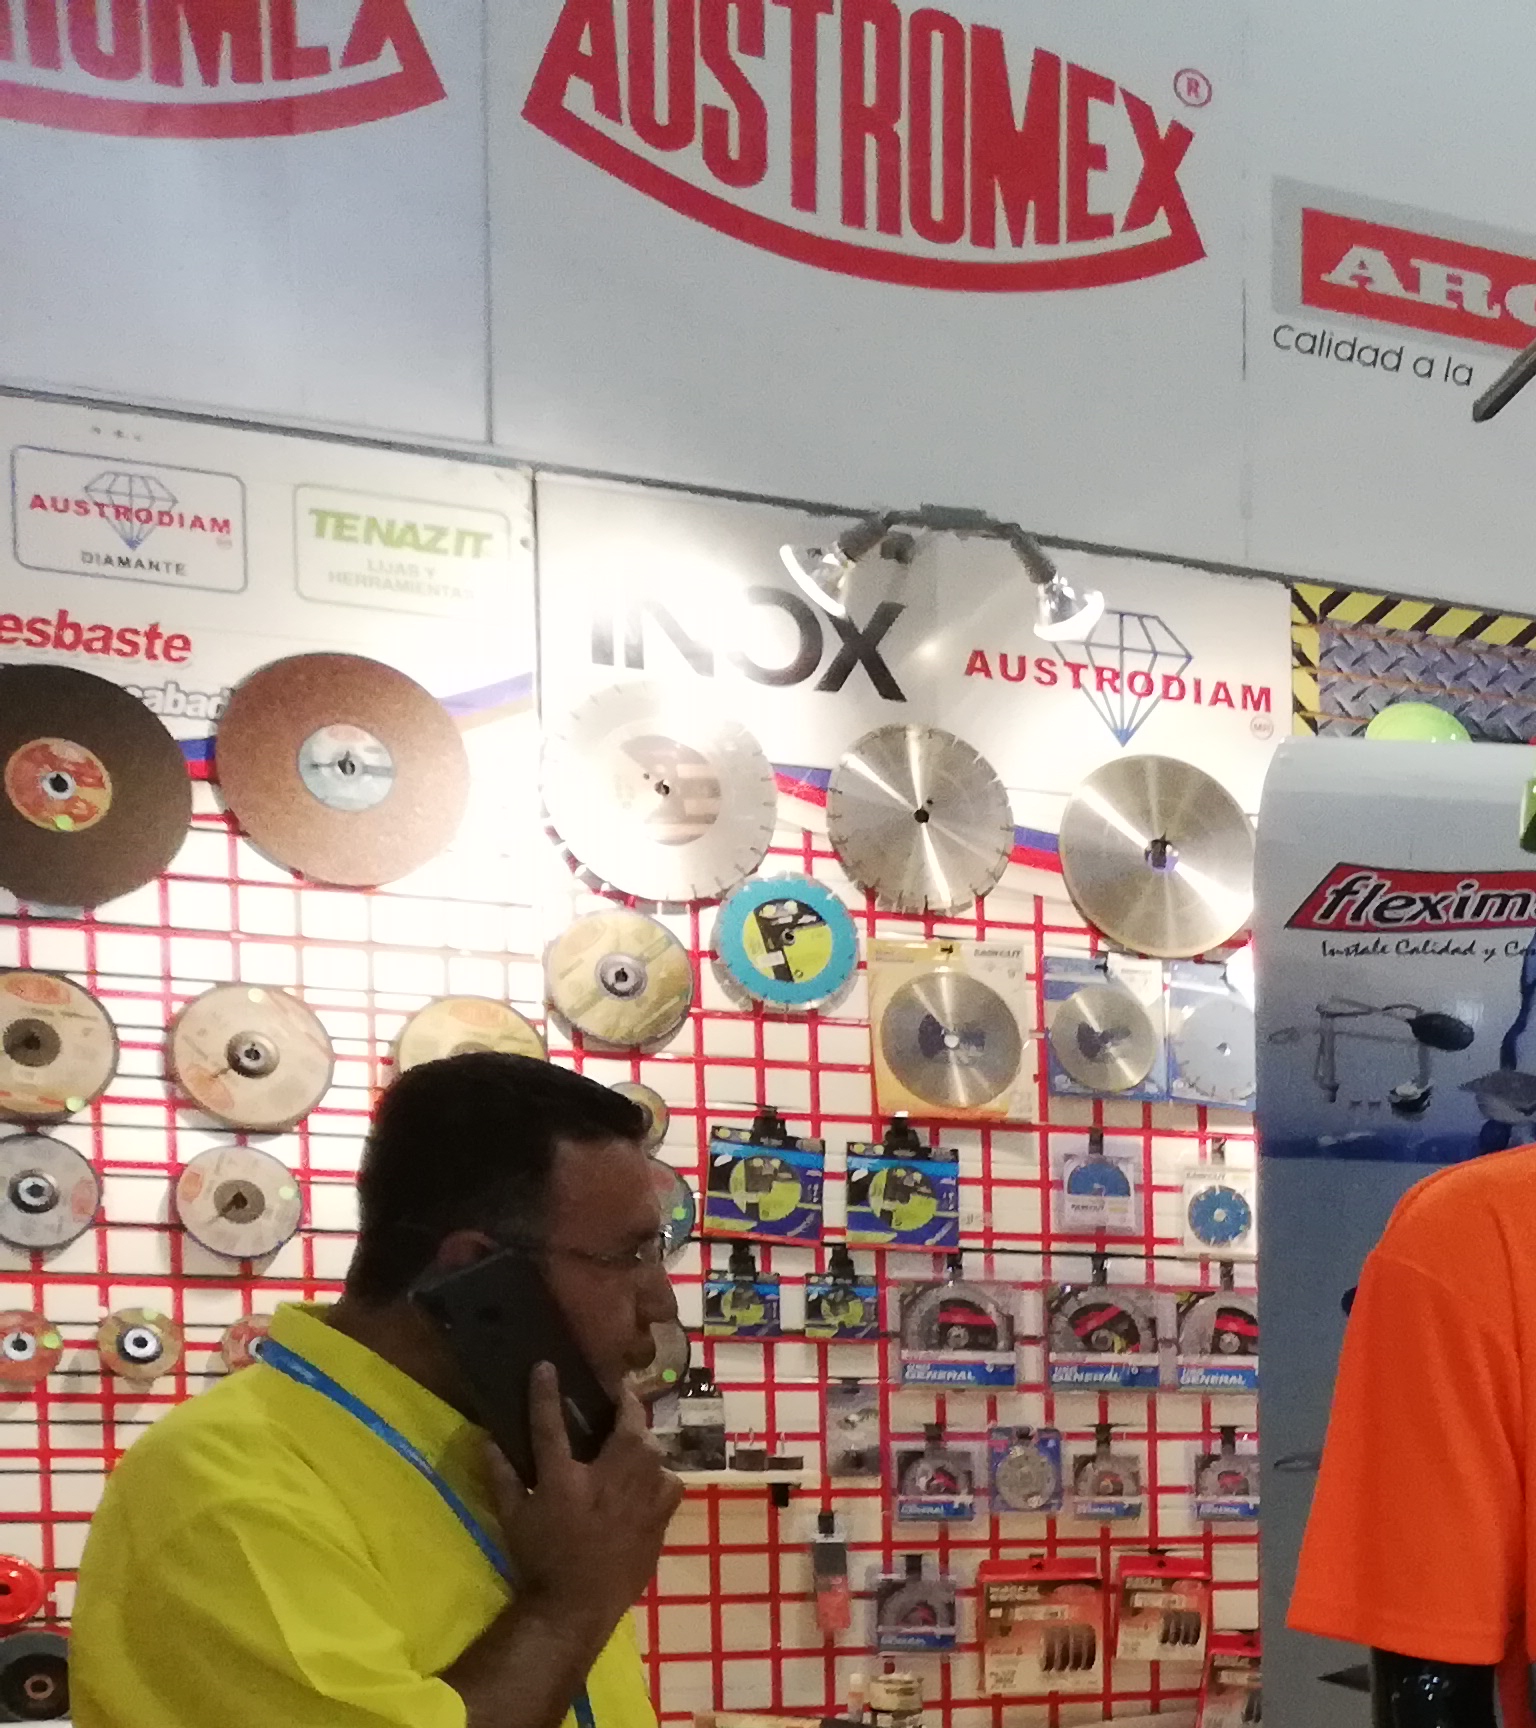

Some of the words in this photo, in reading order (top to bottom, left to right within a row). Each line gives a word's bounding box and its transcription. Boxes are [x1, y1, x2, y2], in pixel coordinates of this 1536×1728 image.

[1272, 323, 1402, 373] Calidad
[1412, 355, 1435, 379] a
[1442, 355, 1474, 387] la
[28, 493, 233, 537] AUSTRODIAM
[308, 507, 494, 560] TENAZIT
[80, 549, 188, 577] DIAMANTE
[964, 649, 1272, 714] AUSTRODIAM
[1395, 937, 1477, 956] Calidad
